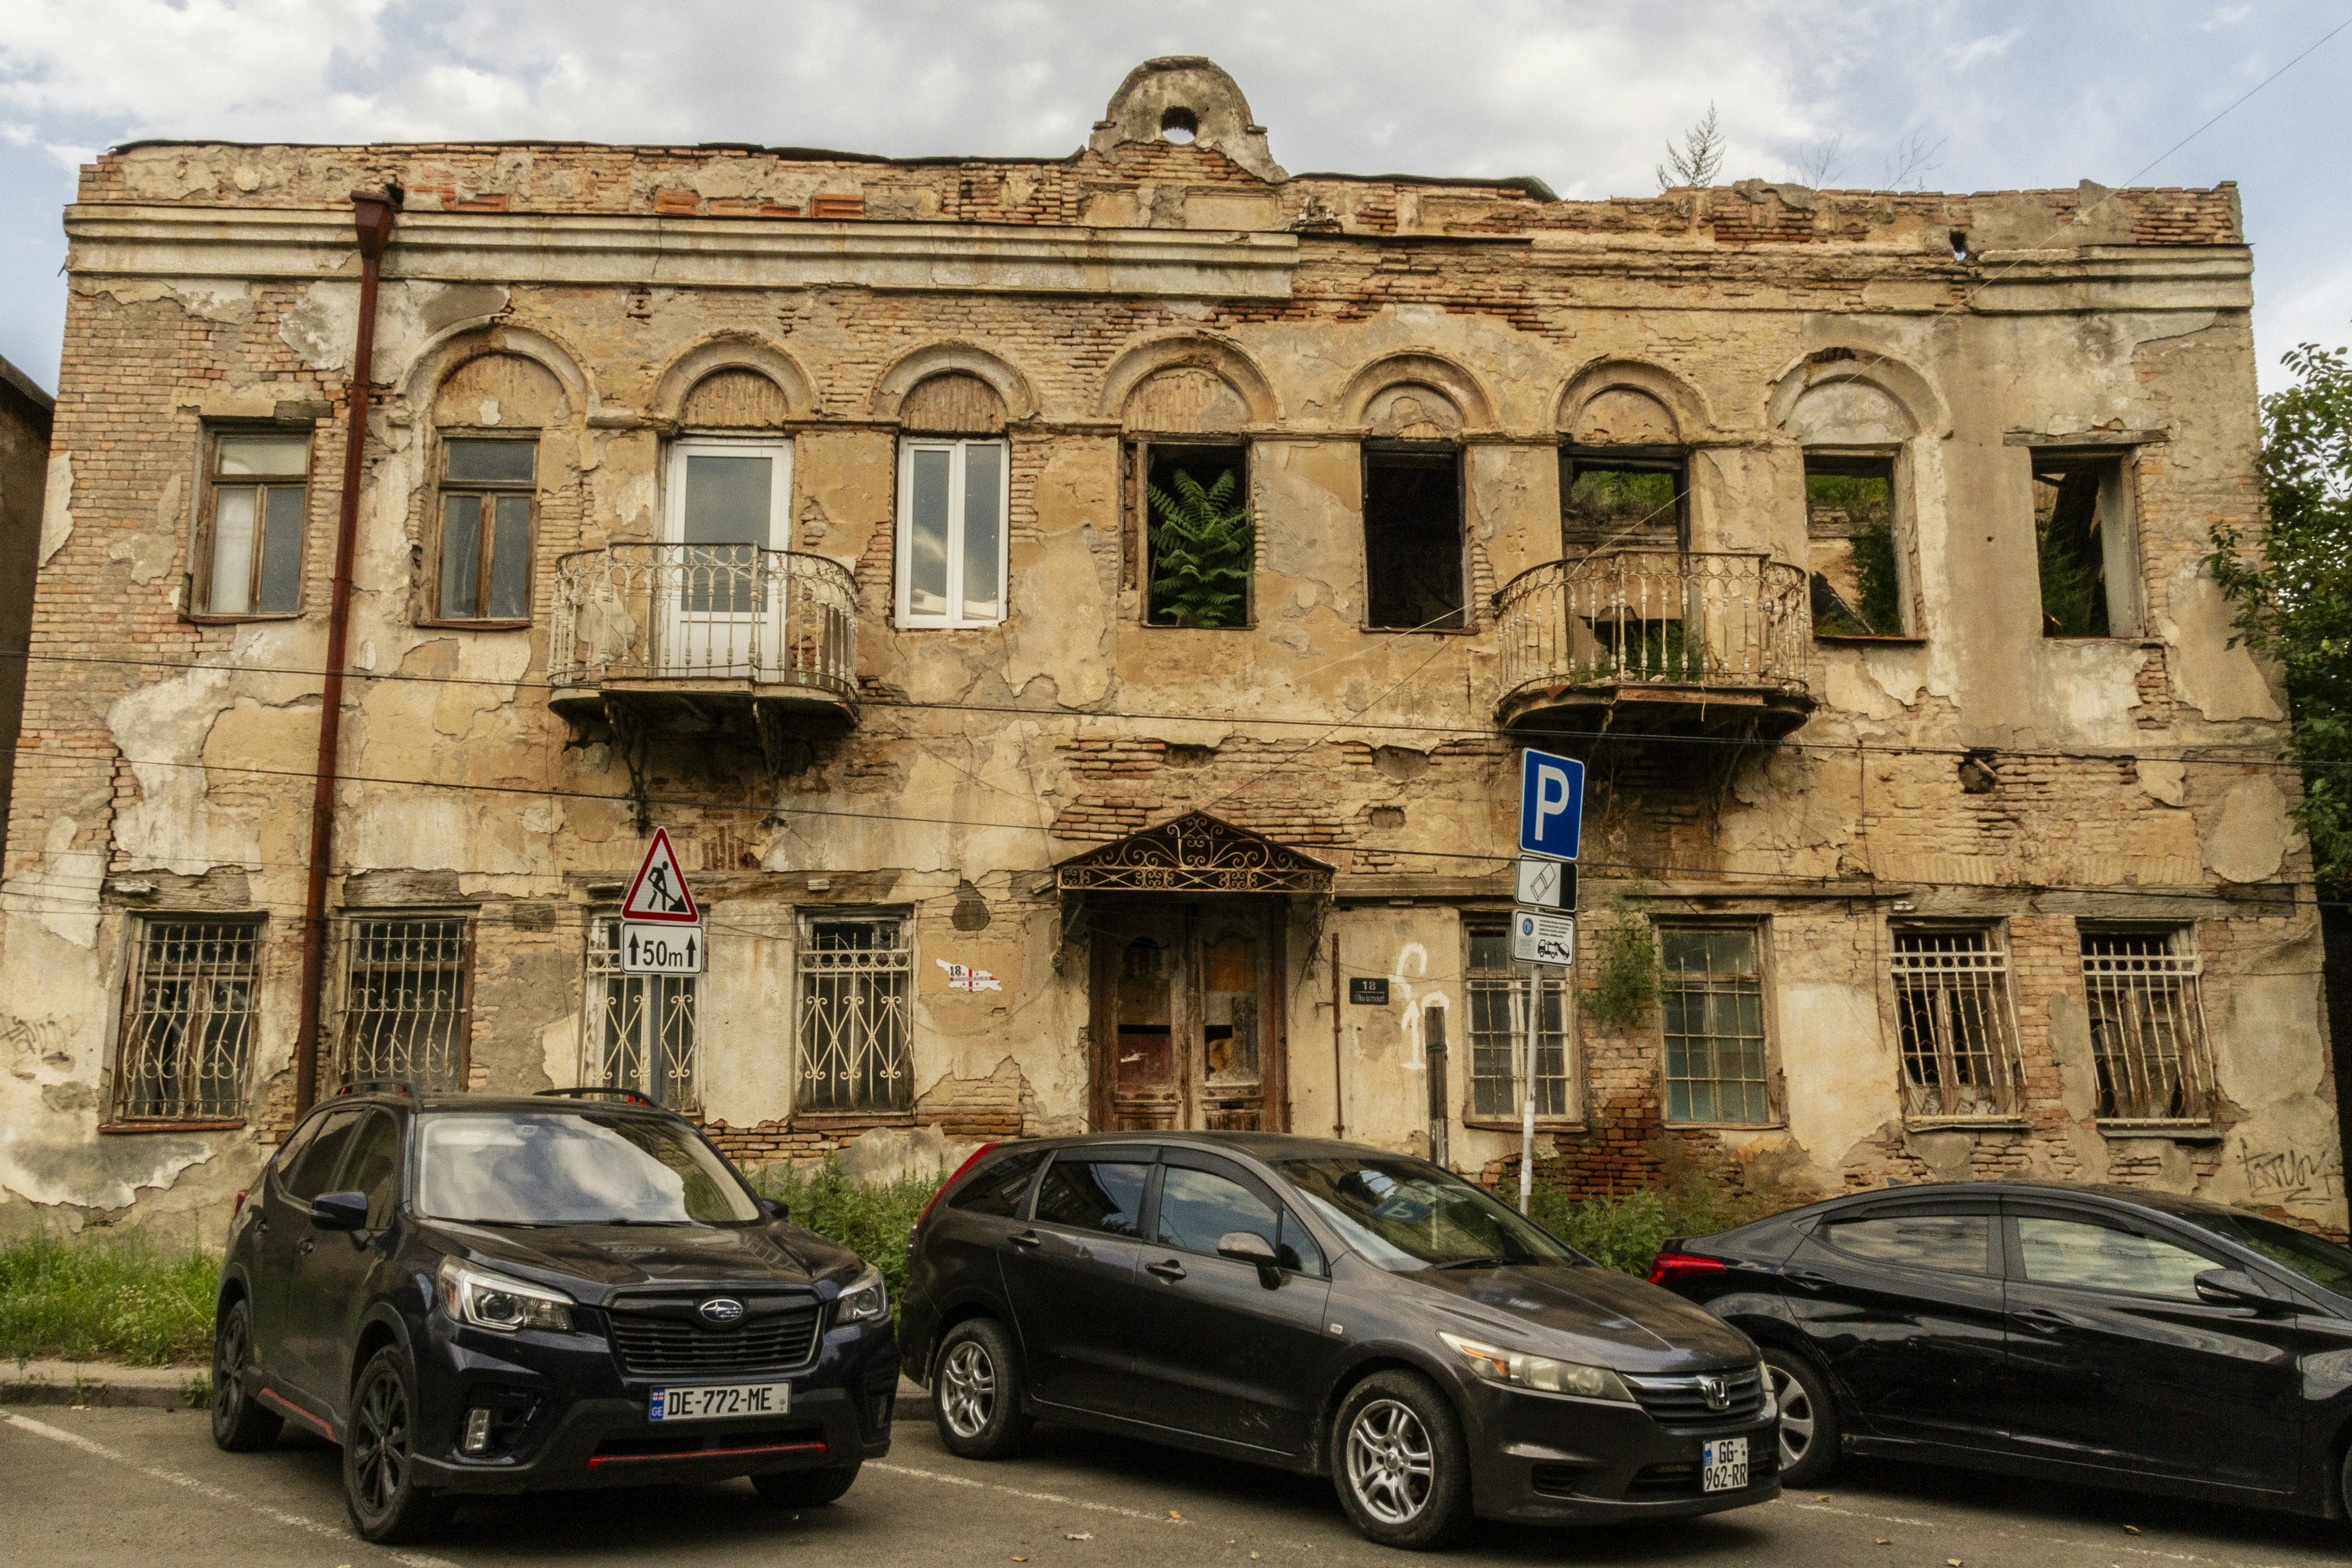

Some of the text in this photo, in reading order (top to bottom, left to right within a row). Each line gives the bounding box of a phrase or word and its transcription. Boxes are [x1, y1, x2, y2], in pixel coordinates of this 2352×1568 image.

[1534, 764, 1570, 841] P
[642, 940, 682, 967] 50m
[950, 965, 961, 976] 18
[1362, 981, 1376, 990] 18
[651, 1406, 663, 1416] GE
[667, 1387, 772, 1416] DE-772-ME
[1705, 1463, 1747, 1490] 962-RR
